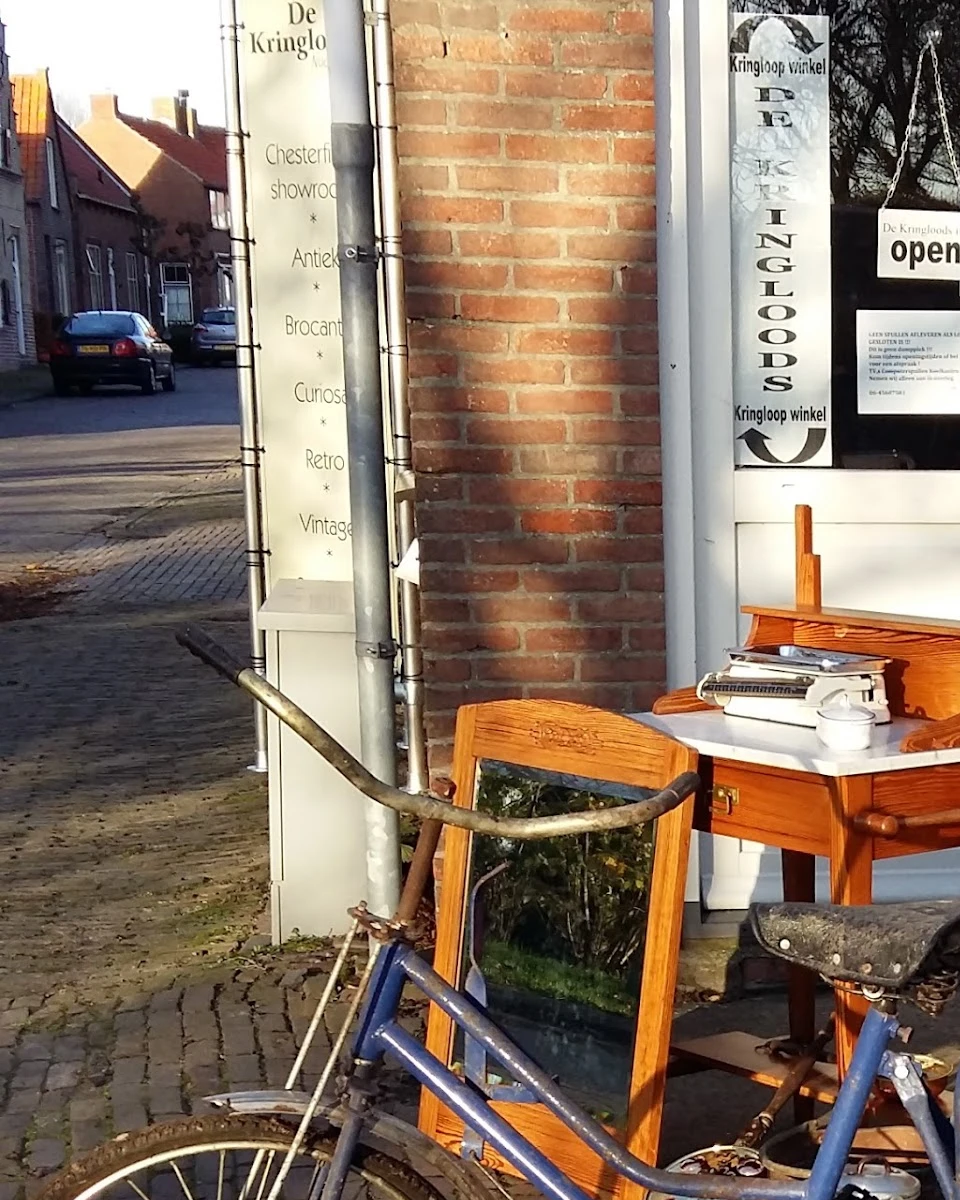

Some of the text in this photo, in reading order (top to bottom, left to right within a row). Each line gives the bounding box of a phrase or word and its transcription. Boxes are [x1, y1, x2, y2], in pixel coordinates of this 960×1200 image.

[288, 1, 316, 25] De
[729, 55, 826, 78] Kringloop winkel
[754, 86, 796, 128] DE
[883, 222, 896, 233] De
[900, 223, 953, 236] Kringloods
[291, 248, 341, 268] Antiek
[890, 239, 960, 270] open
[754, 159, 798, 392] KRINGLOODS
[734, 405, 827, 426] Kringloop winkel
[306, 448, 345, 471] Retro
